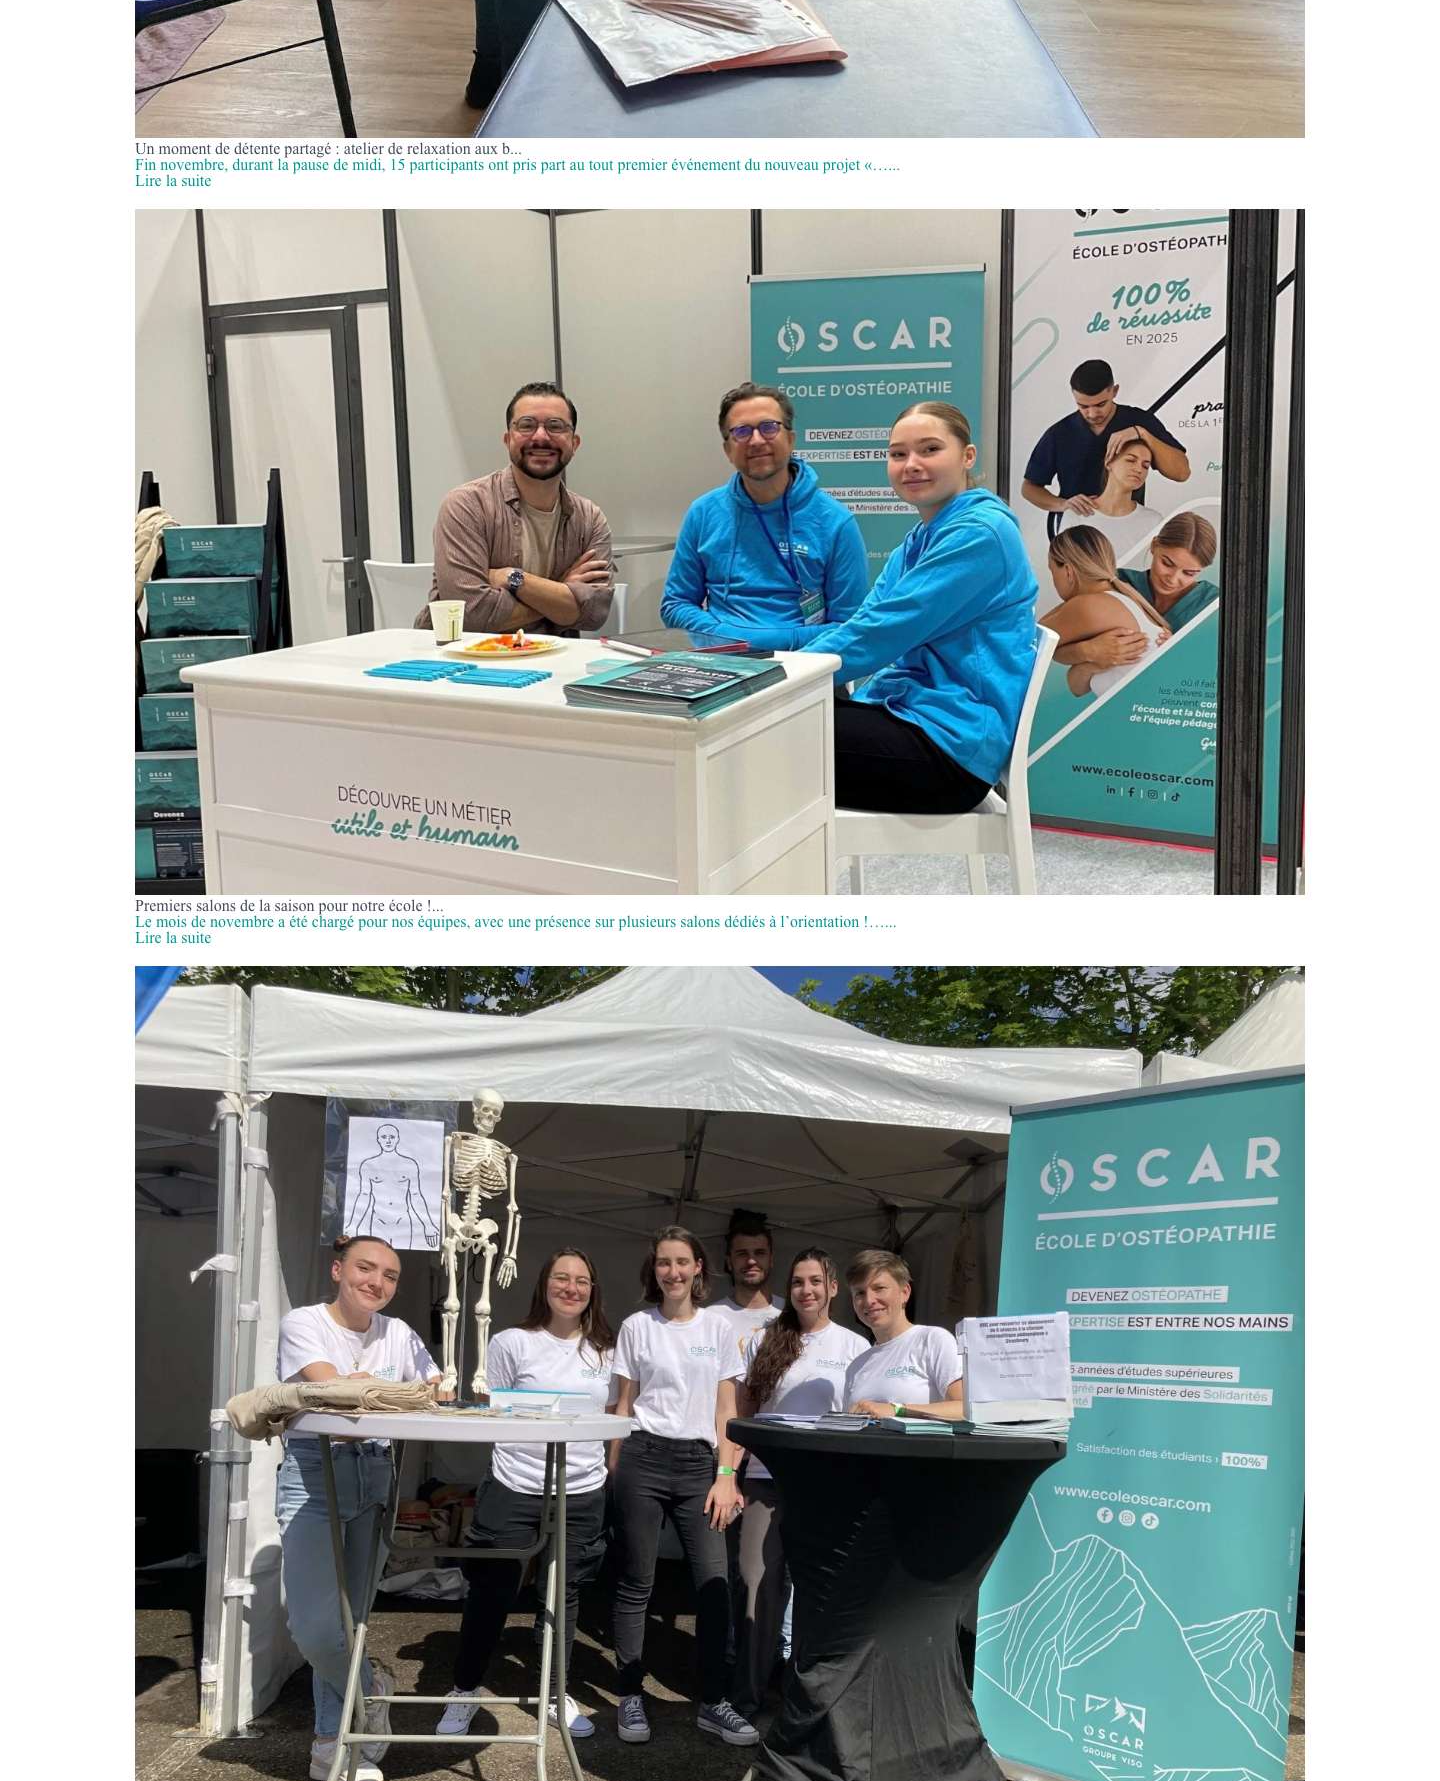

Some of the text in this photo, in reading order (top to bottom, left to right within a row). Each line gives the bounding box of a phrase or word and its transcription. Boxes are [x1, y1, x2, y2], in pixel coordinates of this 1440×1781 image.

[1072, 245, 1119, 259] ÉCOLE
[1086, 303, 1212, 334] de réussite
[777, 316, 952, 360] OSCAR
[1126, 332, 1178, 345] EN 2025
[777, 380, 952, 398] ÉCOLE D'OSTÉOPATHIE
[809, 430, 853, 440] DEVENEZ
[853, 450, 873, 459] EST
[1129, 714, 1142, 722] de
[1172, 708, 1182, 716] et
[1184, 709, 1193, 717] la
[1072, 764, 1214, 787] www.ecoleoscar.com
[337, 785, 512, 827] DÉCOUVRE UN MÉTIER
[331, 808, 519, 851] utile et humain
[1039, 1135, 1282, 1205] OSCAR
[1035, 1222, 1277, 1250] ÉCOLE D’OSTÉOPATHIE
[1071, 1288, 1222, 1302] DEVENEZ OSTÉOPATHE
[1127, 1316, 1289, 1329] EST ENTRE NOS MAINS
[1077, 1366, 1116, 1376] années
[1165, 1369, 1234, 1381] supérieures
[1076, 1442, 1213, 1464] Satisfaction des étudiants
[1054, 1485, 1212, 1513] www.ecoleoscar.com
[1083, 1724, 1144, 1751] OSCAR
[1082, 1745, 1118, 1762] GROUPE
